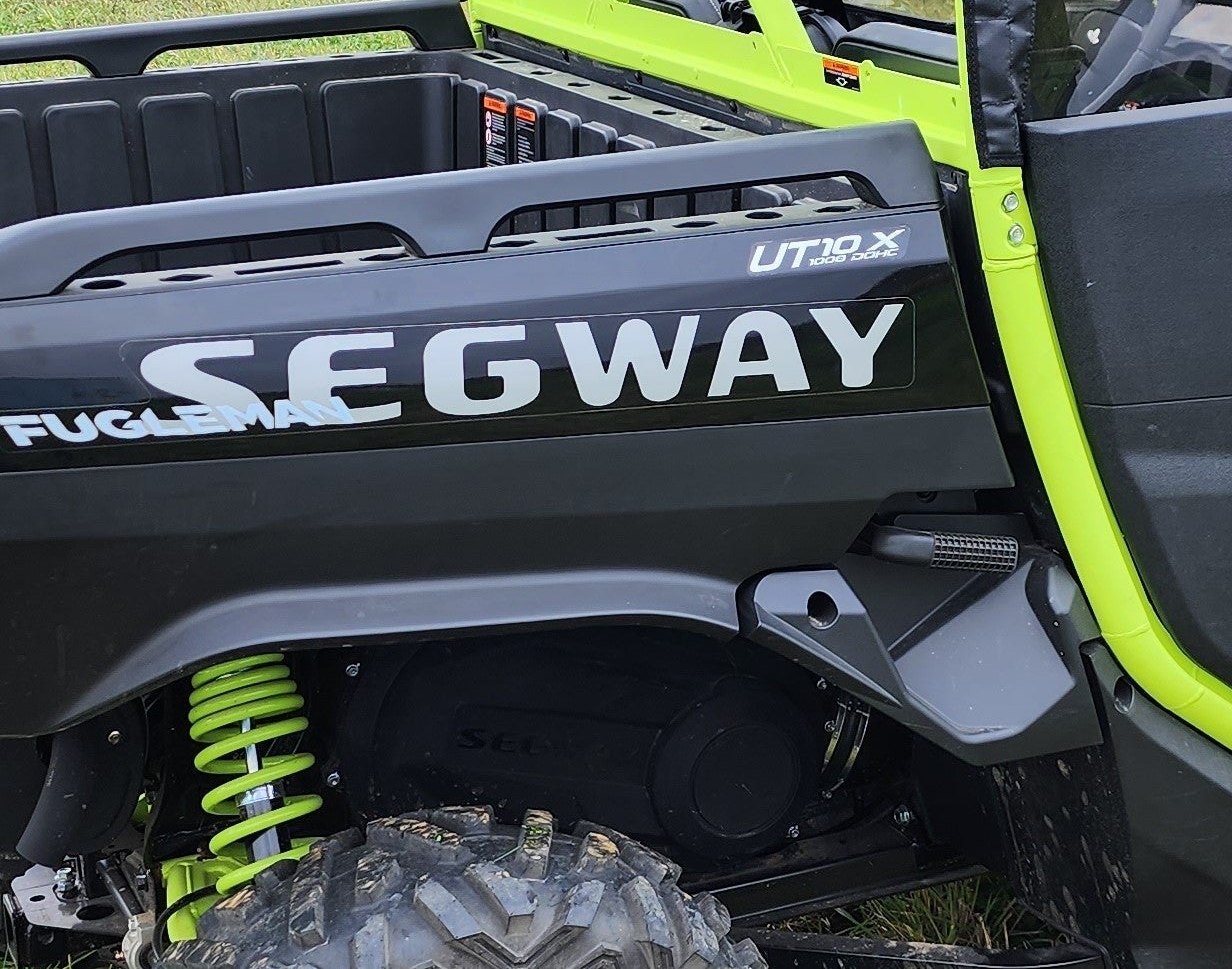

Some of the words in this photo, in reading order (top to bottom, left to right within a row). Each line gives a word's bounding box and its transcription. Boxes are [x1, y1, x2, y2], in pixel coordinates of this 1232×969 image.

[750, 235, 862, 273] UT10
[867, 228, 905, 249] X
[140, 303, 905, 432] SEGWAY
[0, 396, 354, 447] FUGLEMAN
